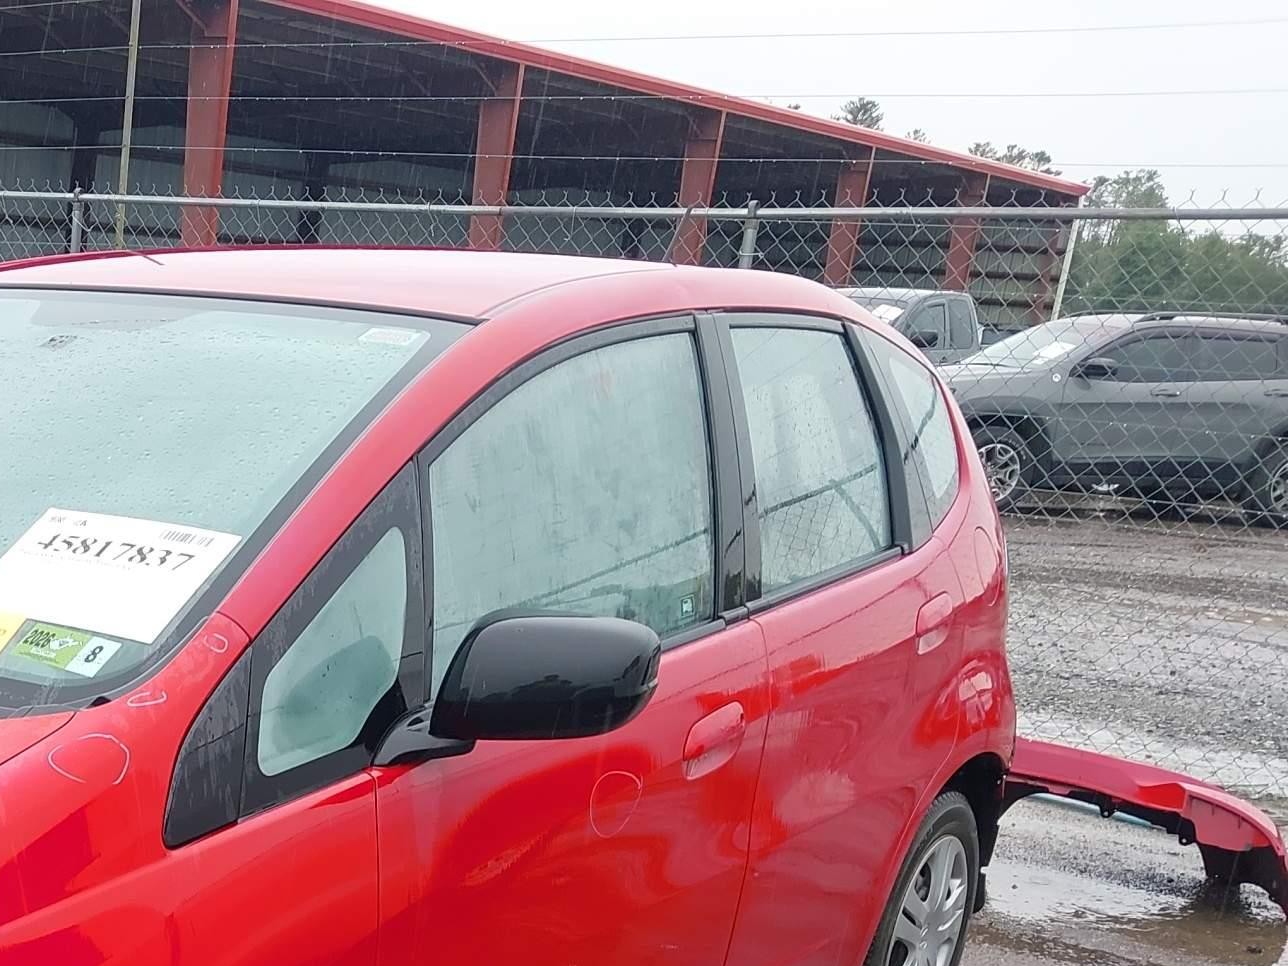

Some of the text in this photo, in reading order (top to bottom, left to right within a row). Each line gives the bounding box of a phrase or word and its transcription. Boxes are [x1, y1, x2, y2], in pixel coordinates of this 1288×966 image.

[37, 533, 196, 571] 45817837
[22, 628, 57, 649] 2026
[83, 645, 104, 664] 8
